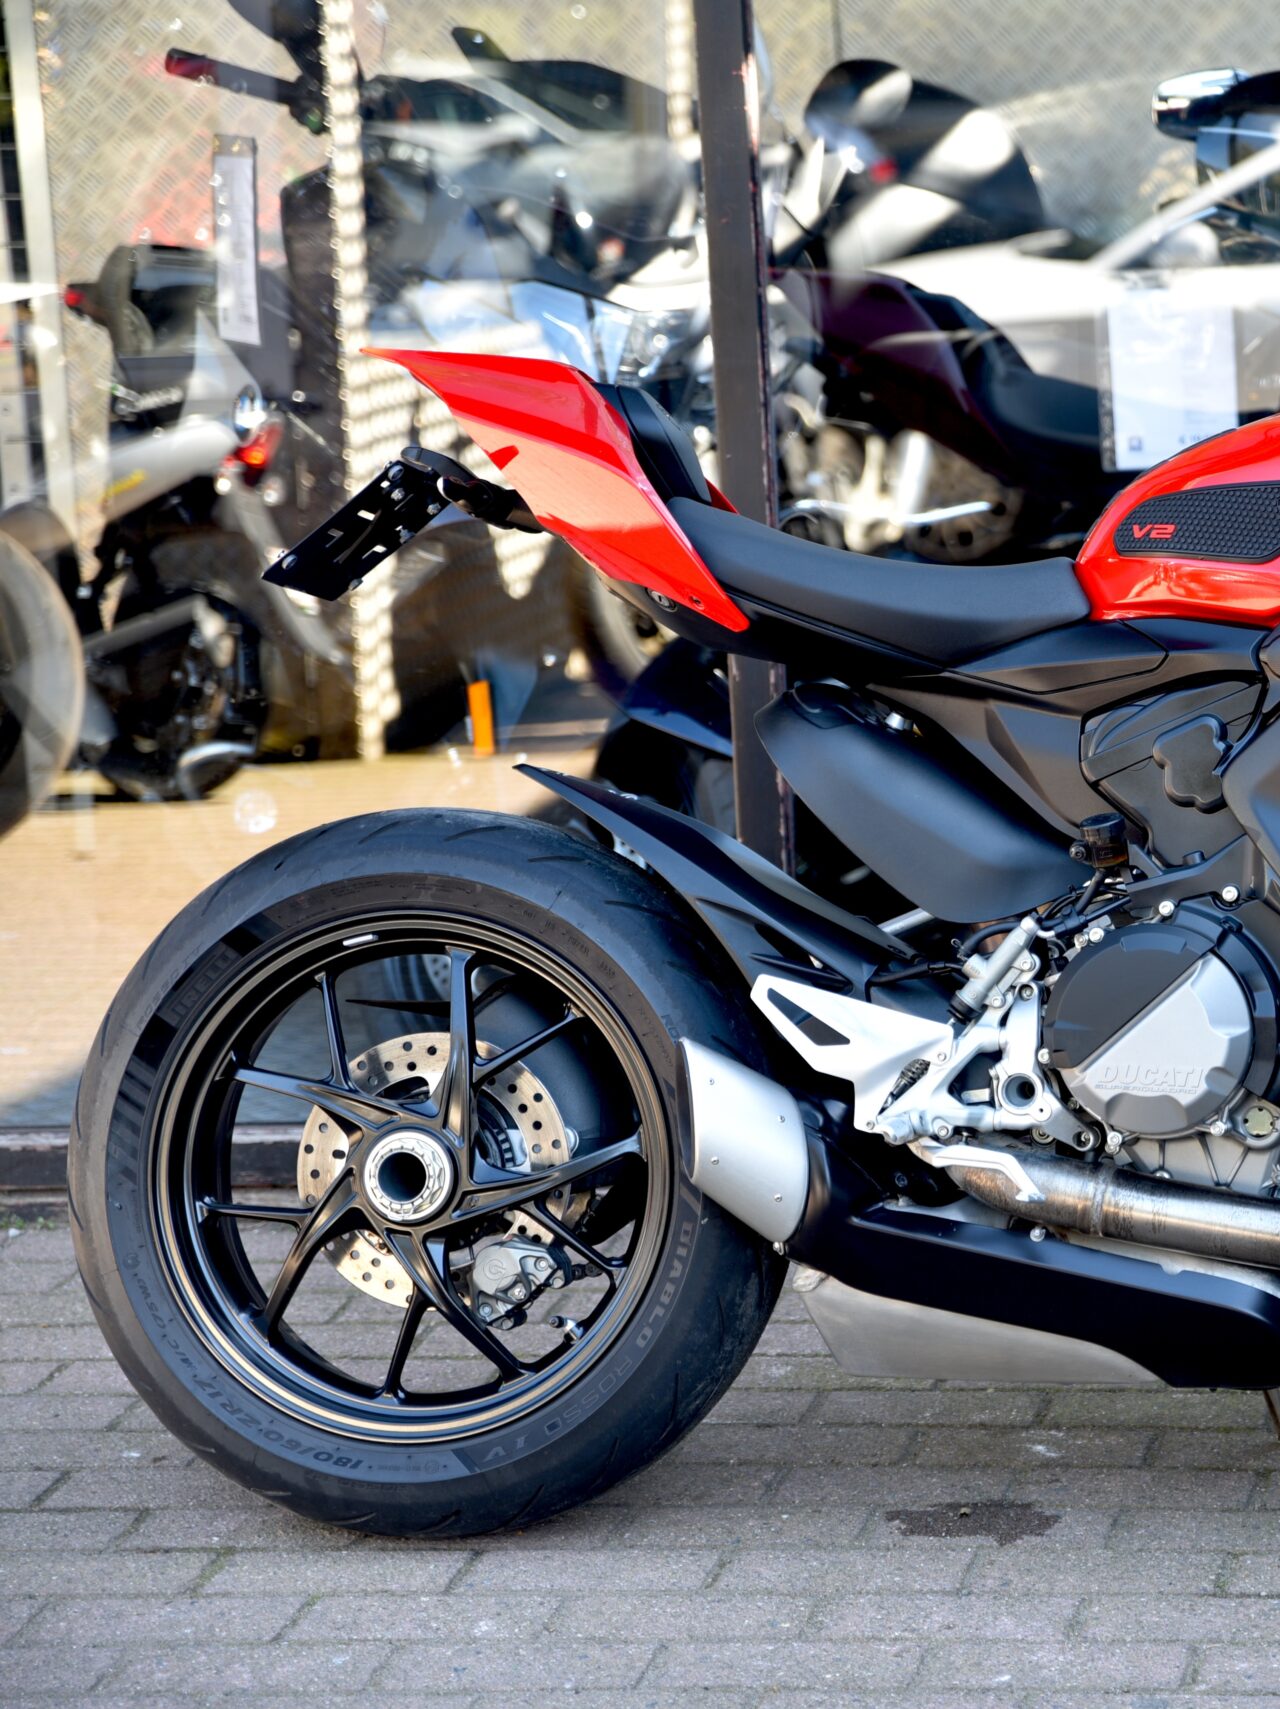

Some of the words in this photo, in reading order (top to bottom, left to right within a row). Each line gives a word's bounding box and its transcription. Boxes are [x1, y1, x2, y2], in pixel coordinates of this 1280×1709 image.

[1132, 524, 1176, 539] V2
[157, 943, 241, 1029] PIRELLI
[1097, 1063, 1205, 1088] DUCATI
[636, 1221, 695, 1348] DIABLO
[192, 1379, 262, 1429] ZR17
[544, 1356, 633, 1436] ROSSO
[263, 1430, 364, 1469] 180/60
[482, 1435, 529, 1462] IV
